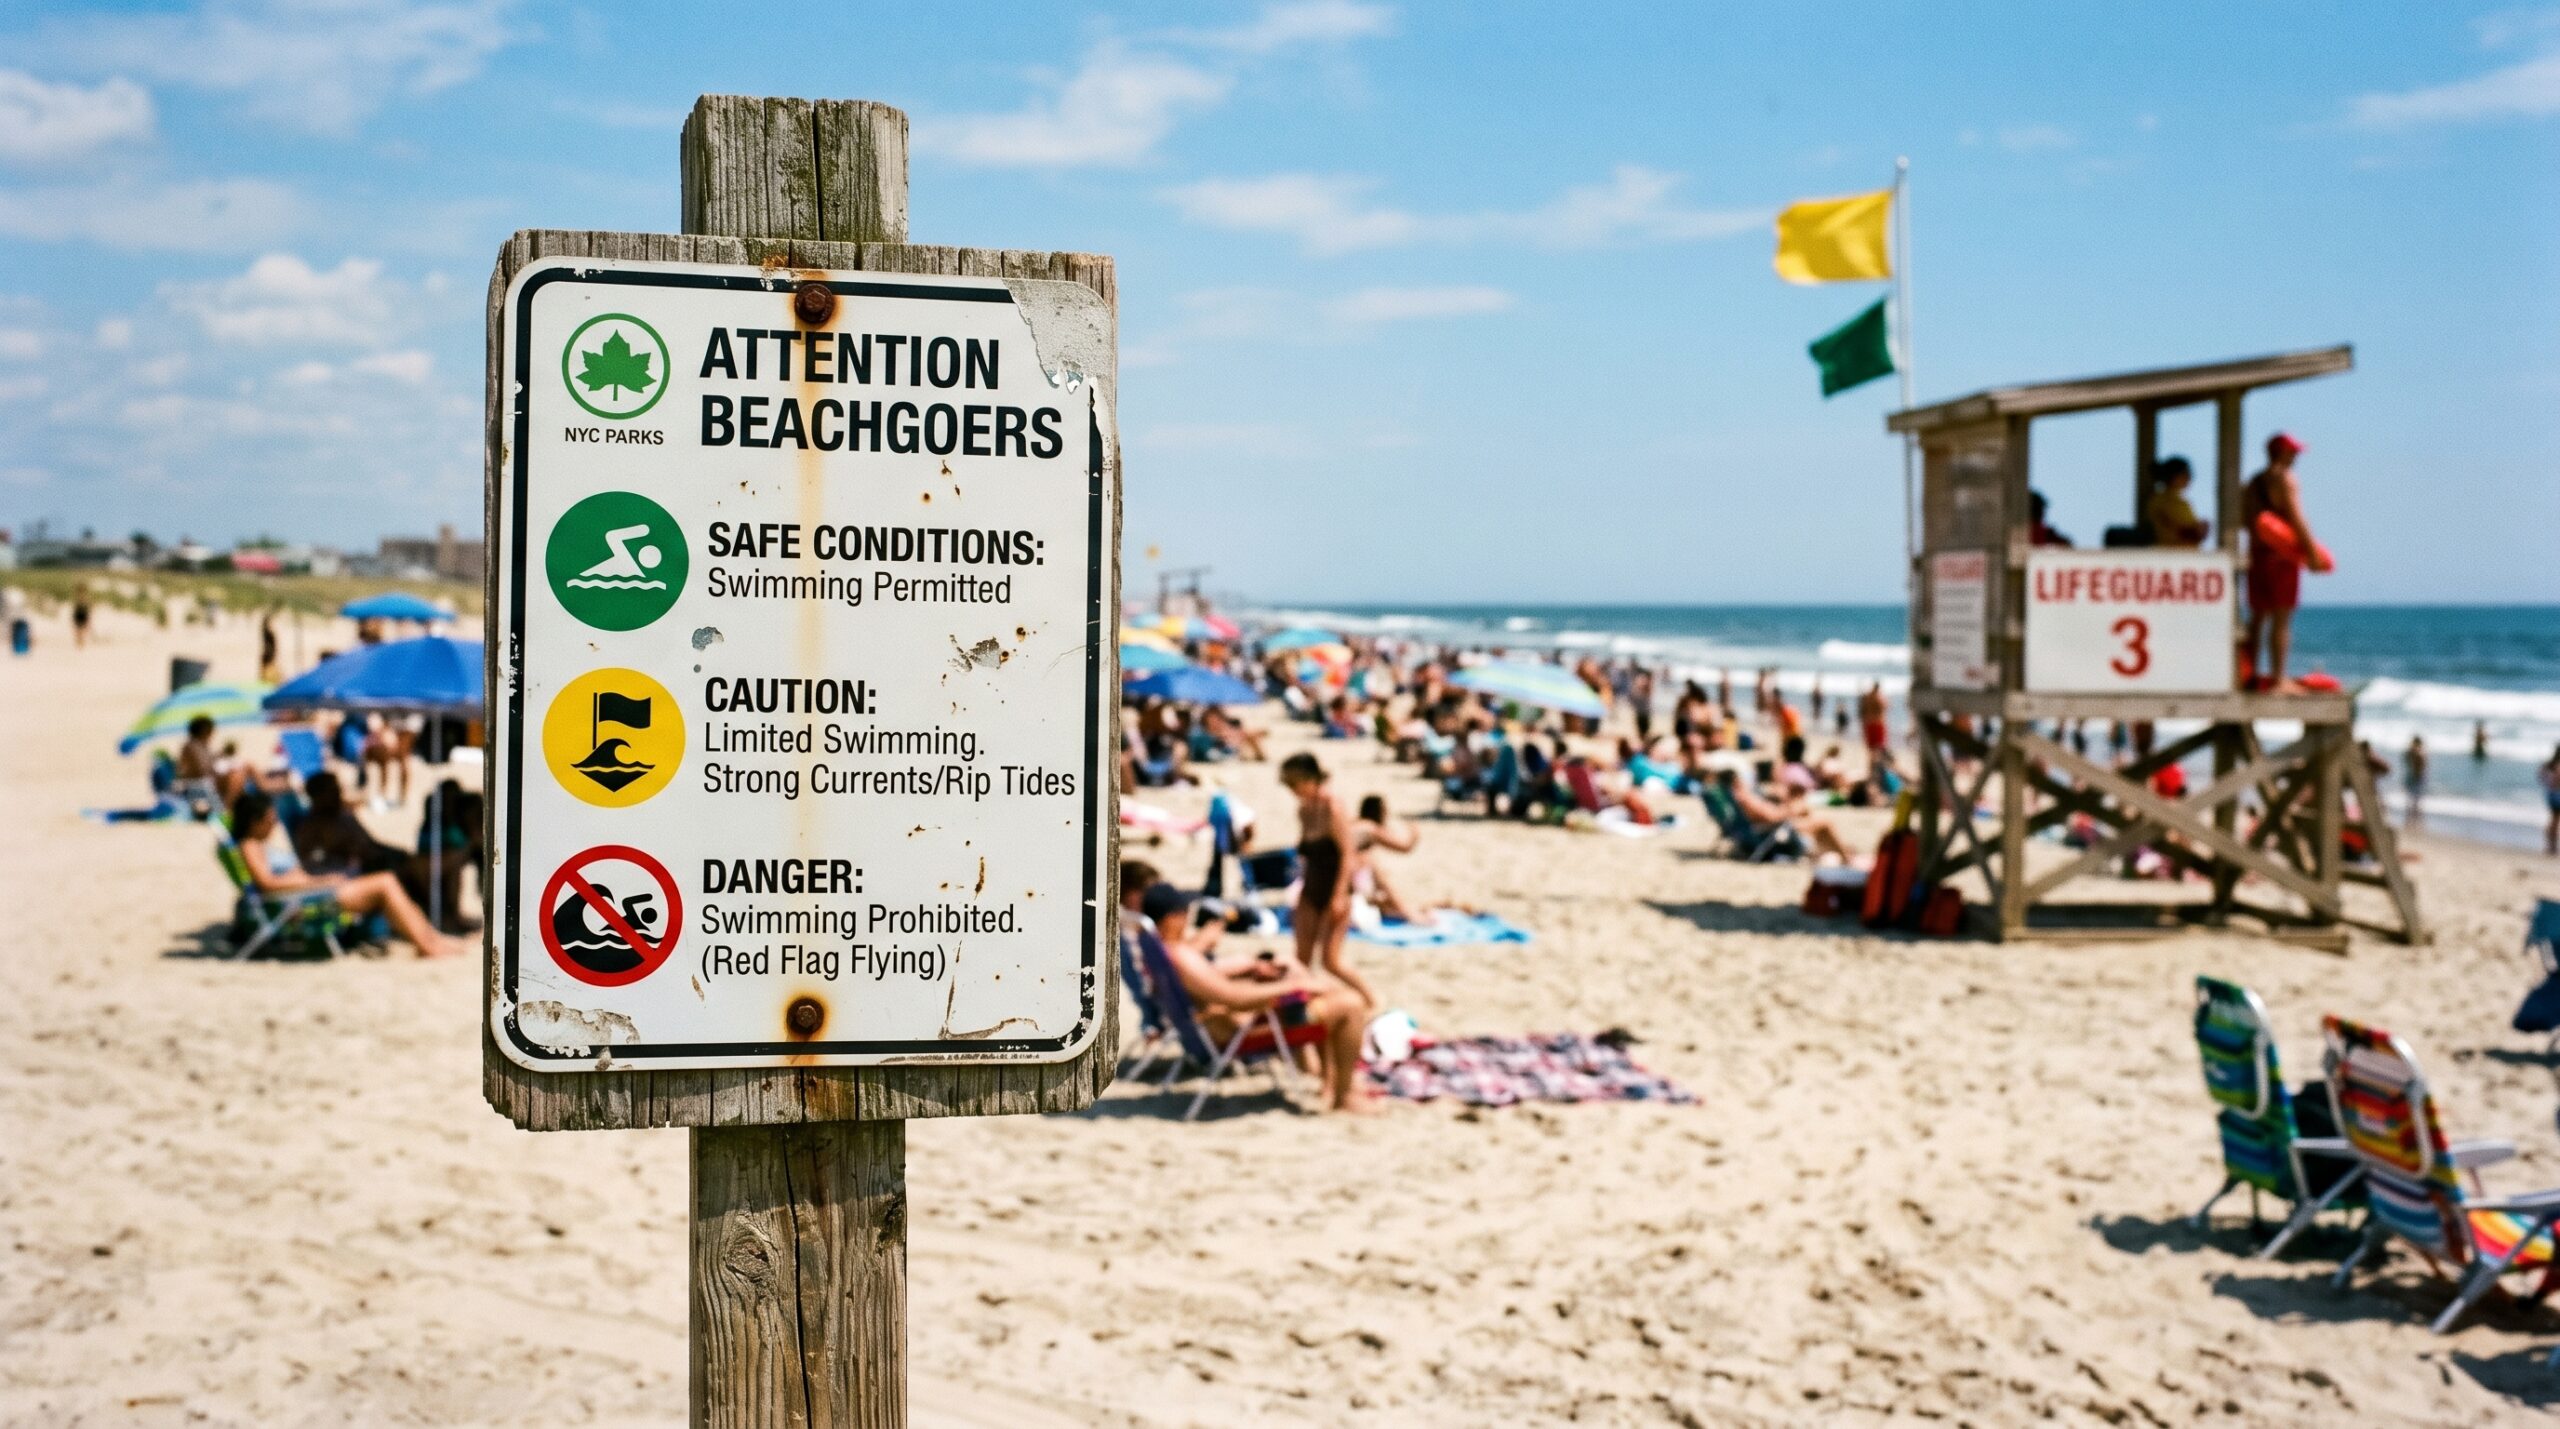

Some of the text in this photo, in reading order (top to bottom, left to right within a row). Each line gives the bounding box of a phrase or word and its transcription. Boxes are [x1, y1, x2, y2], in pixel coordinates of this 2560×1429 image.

[699, 327, 999, 390] ATTENTION
[565, 427, 664, 446] NYC PARKS
[701, 394, 1063, 459] BEACHGOERS
[708, 521, 1044, 566] SAFE CONDITIONS:
[708, 566, 1011, 607] Swimming Permitted
[2037, 569, 2223, 602] LIFEGUARD
[2111, 617, 2150, 677] 3
[705, 676, 876, 715] CAUTION:
[705, 722, 985, 762] Limited Swimming.
[703, 762, 1075, 802] Strong Currents/Rip Tides
[703, 858, 863, 895] DANGER:
[701, 903, 1023, 941] Swimming Prohibited.
[701, 943, 946, 982] (Red Flag Flying)
